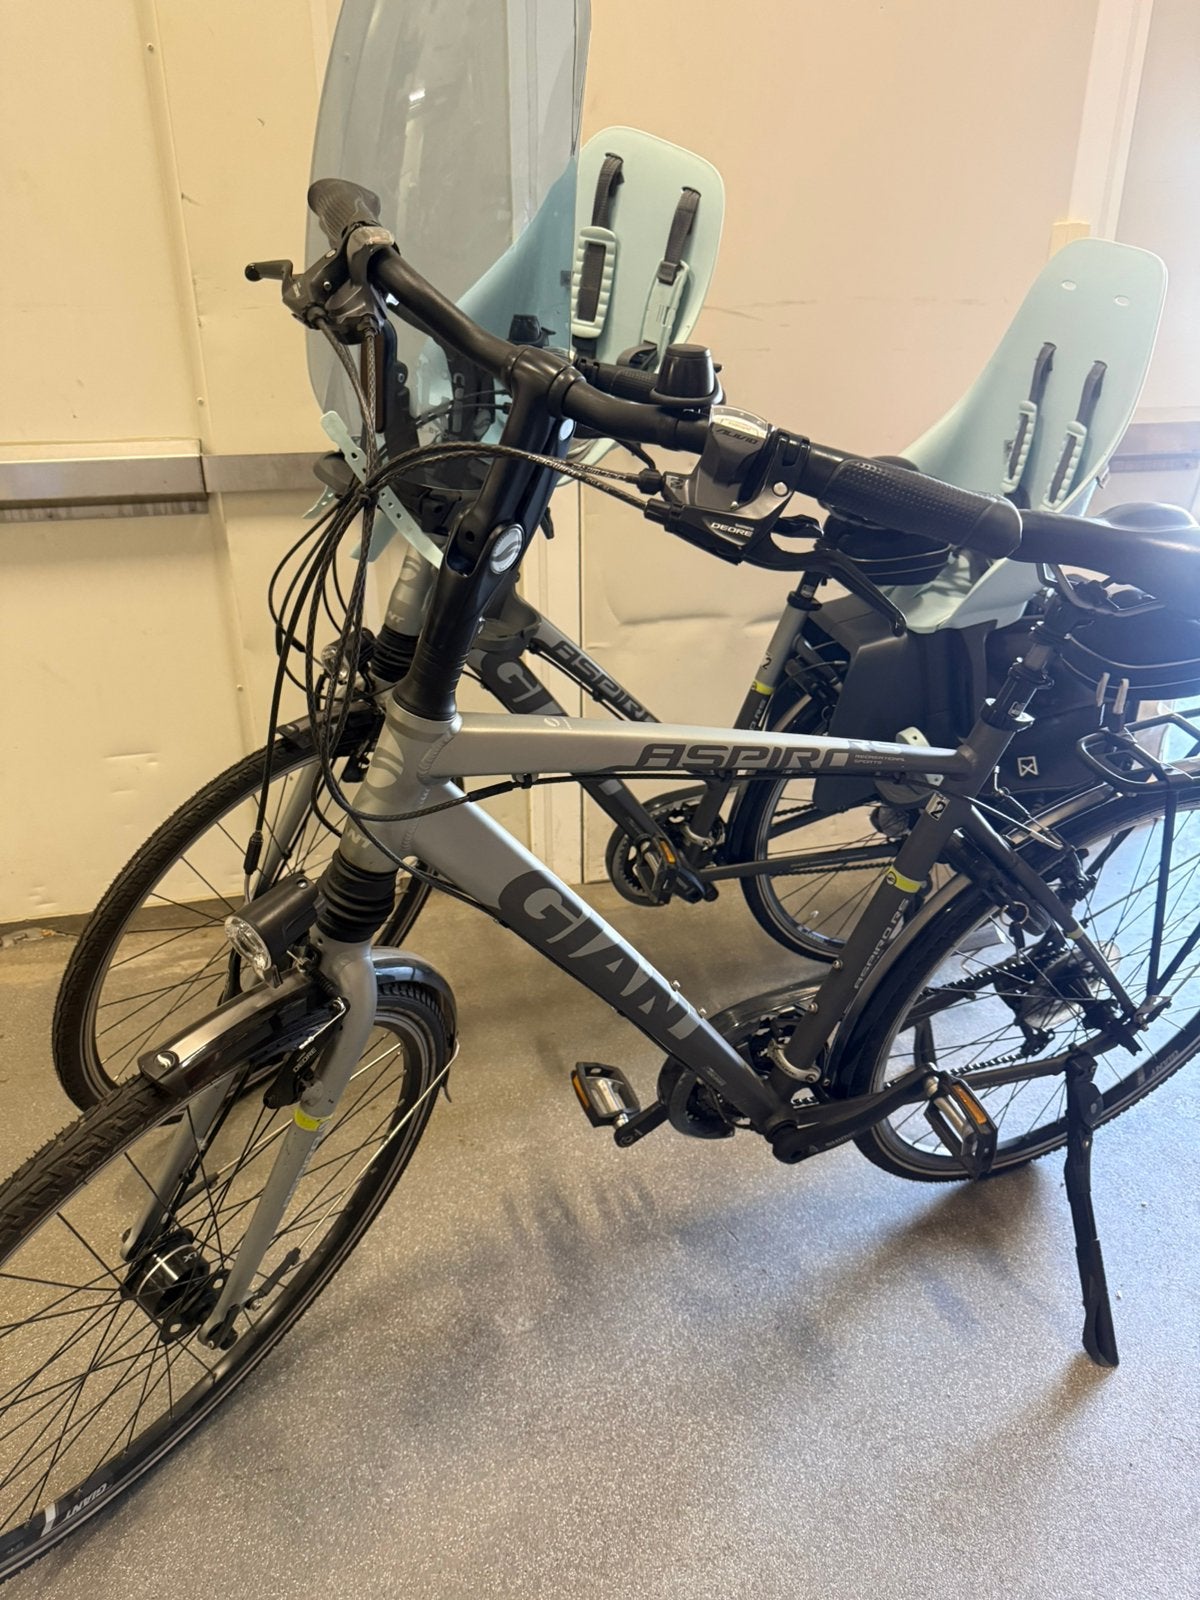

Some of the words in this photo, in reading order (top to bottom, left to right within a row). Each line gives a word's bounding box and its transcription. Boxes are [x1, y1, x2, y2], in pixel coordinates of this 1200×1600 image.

[711, 522, 754, 537] DEORE
[634, 742, 850, 770] ASPIRO
[853, 926, 893, 989] ASPIRO
